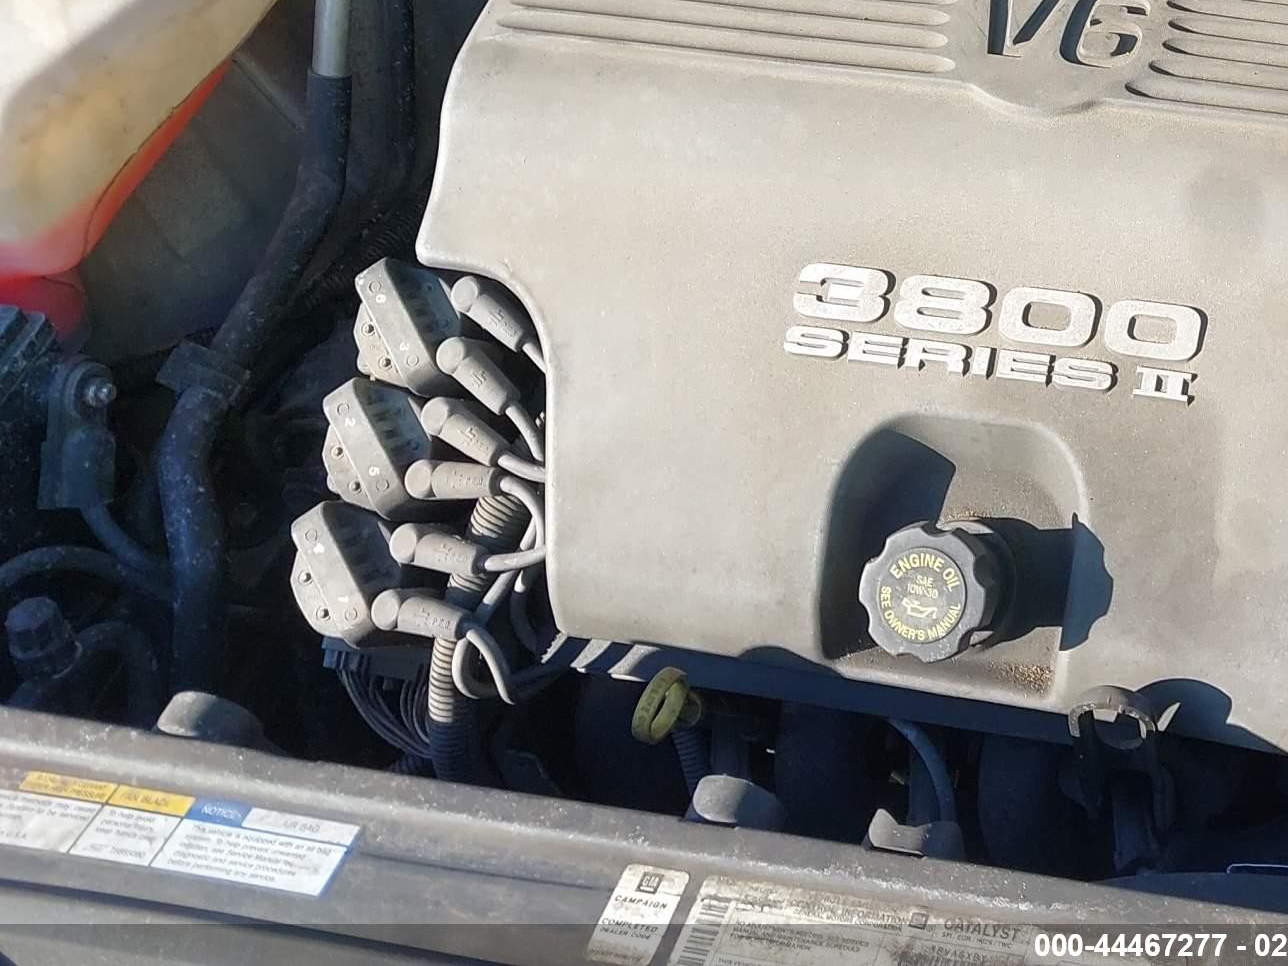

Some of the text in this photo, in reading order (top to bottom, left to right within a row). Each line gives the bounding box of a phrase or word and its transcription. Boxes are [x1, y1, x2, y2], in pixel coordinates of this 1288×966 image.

[793, 262, 1208, 362] 3800
[783, 324, 1198, 406] SERIES II
[344, 418, 356, 427] 2
[369, 466, 380, 476] 5
[890, 552, 960, 592] ENGINE OIL
[916, 574, 934, 587] SAE
[907, 584, 938, 599] 10W-30
[881, 586, 961, 640] SEE OWNER'S MANUAL
[200, 803, 236, 818] NOTICE
[614, 895, 668, 909] CAMPAIGN
[600, 927, 628, 936] DEALER
[602, 918, 658, 933] COMPLETED
[944, 917, 1020, 942] CATALYST
